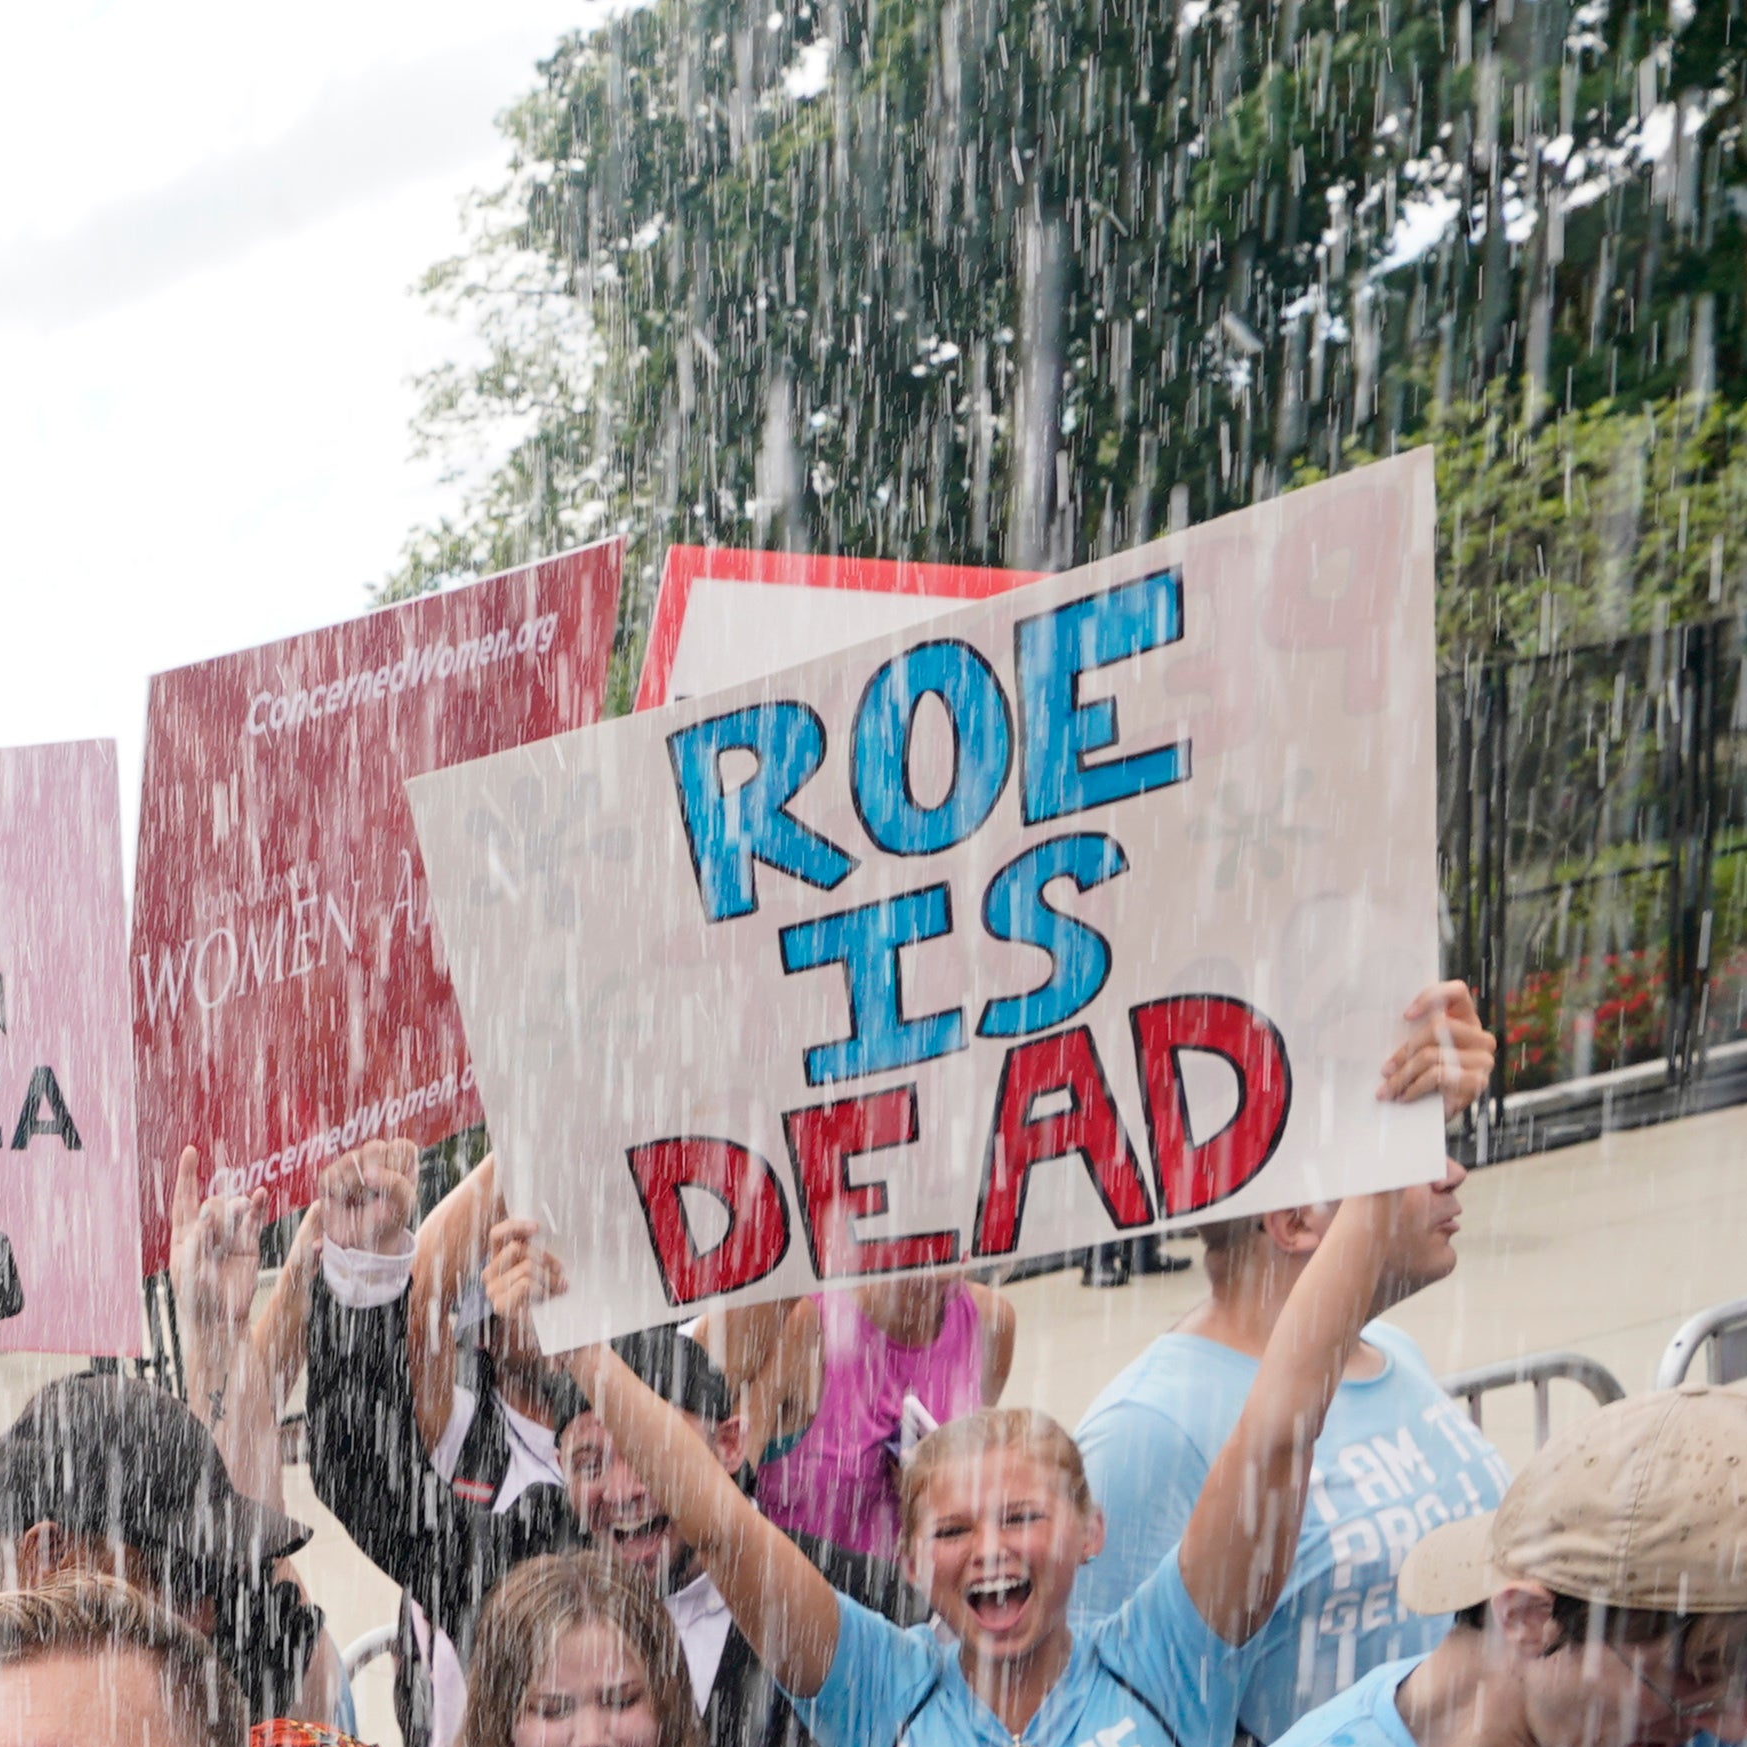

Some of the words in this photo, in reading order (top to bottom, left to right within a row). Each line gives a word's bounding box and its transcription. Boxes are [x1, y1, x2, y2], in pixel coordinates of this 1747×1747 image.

[246, 610, 559, 736] ConcernedWomen.org
[667, 564, 1193, 922] ROE
[139, 892, 356, 1028] WOMEN
[778, 833, 1130, 1086] IS
[209, 1062, 478, 1200] ConcernedWomen.o
[625, 992, 1294, 1305] DEAD
[1338, 1425, 1438, 1507] AM
